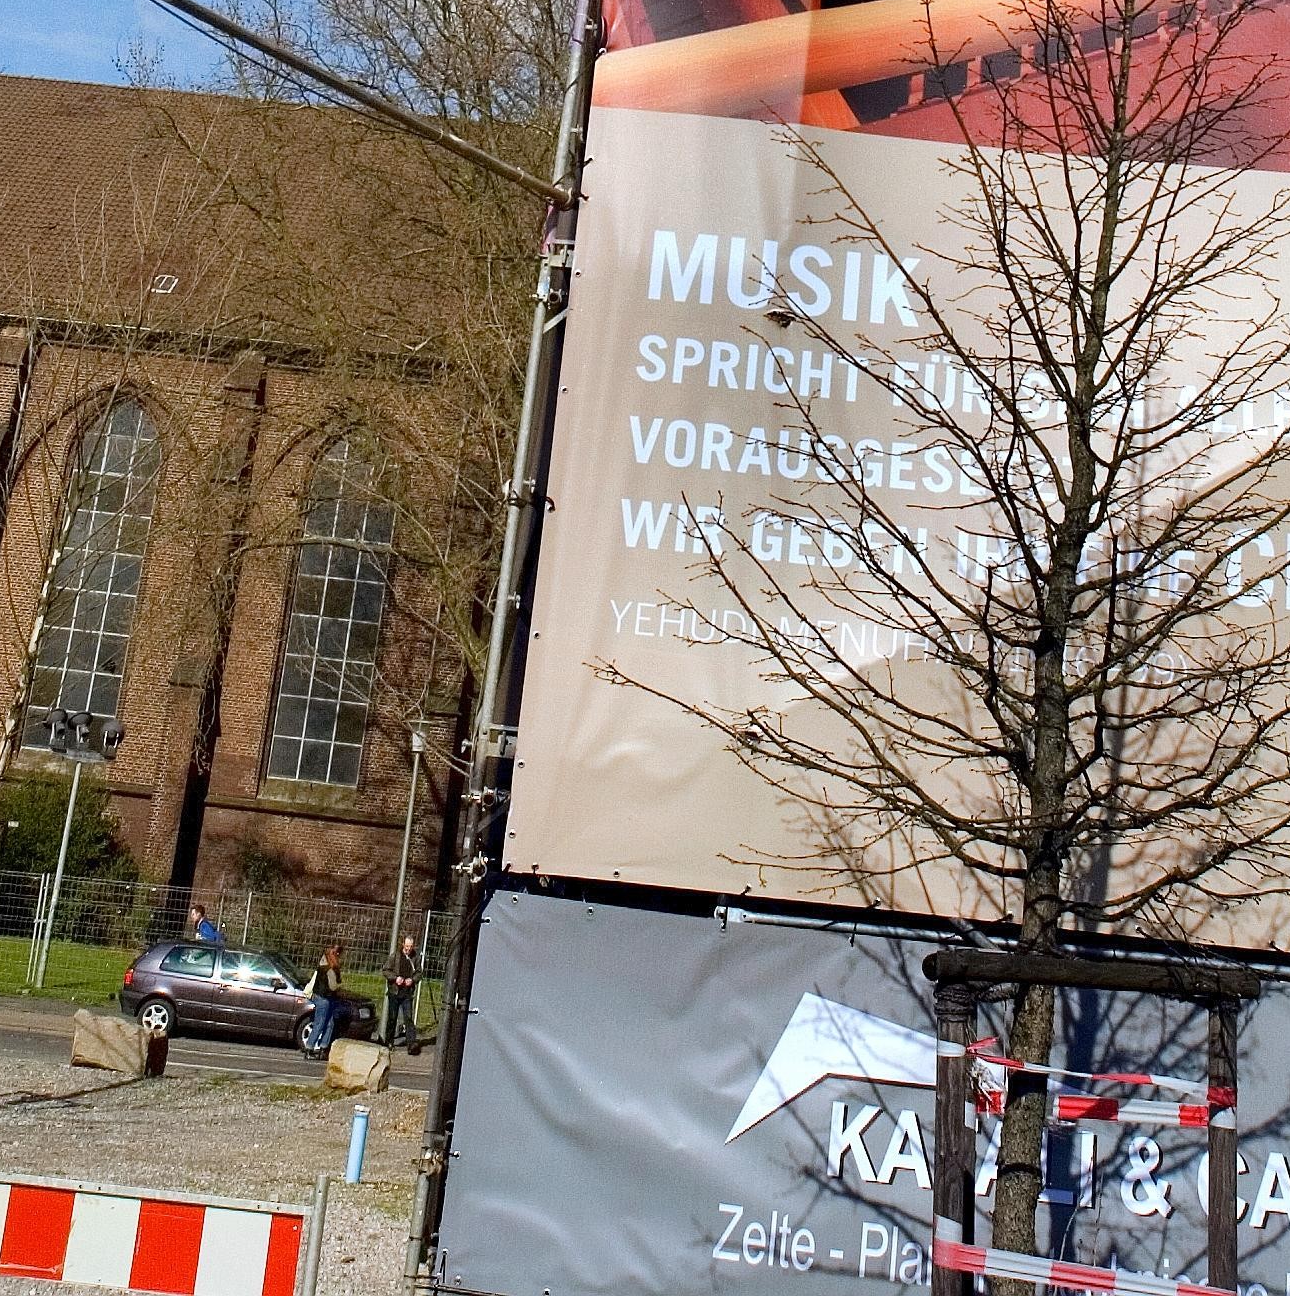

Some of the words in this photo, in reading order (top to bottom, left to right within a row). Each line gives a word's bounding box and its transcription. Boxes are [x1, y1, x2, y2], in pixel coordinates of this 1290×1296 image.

[647, 229, 922, 328] MUSIK
[635, 334, 869, 402] SPRICHT
[891, 354, 992, 416] FÜR
[620, 498, 725, 556] WIR
[1120, 1135, 1176, 1219] &
[711, 1202, 817, 1272] Zelte
